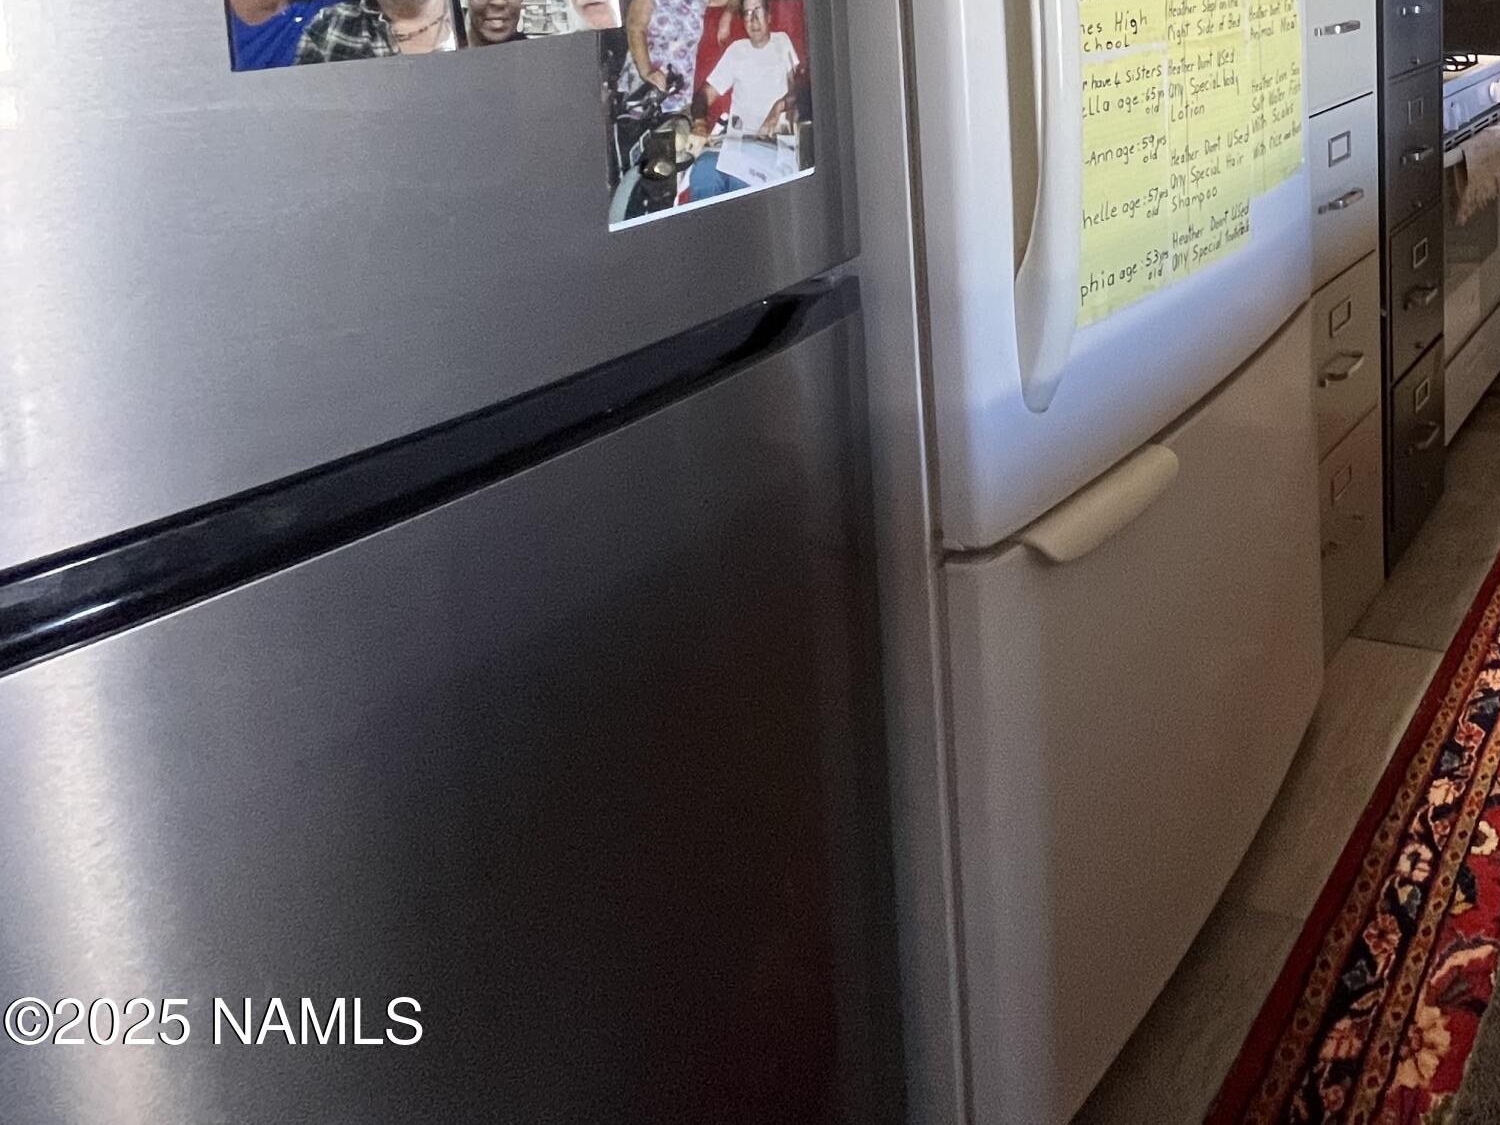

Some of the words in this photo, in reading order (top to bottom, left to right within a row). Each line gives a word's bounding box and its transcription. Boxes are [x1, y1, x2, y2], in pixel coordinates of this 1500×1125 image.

[1114, 8, 1148, 35] High
[1083, 34, 1131, 53] chool
[1091, 72, 1112, 90] have
[1170, 100, 1206, 123] Lotion
[1172, 186, 1218, 213] Shampoo
[1082, 199, 1118, 229] helle
[1172, 223, 1205, 249] Heather
[1080, 270, 1116, 308] phia
